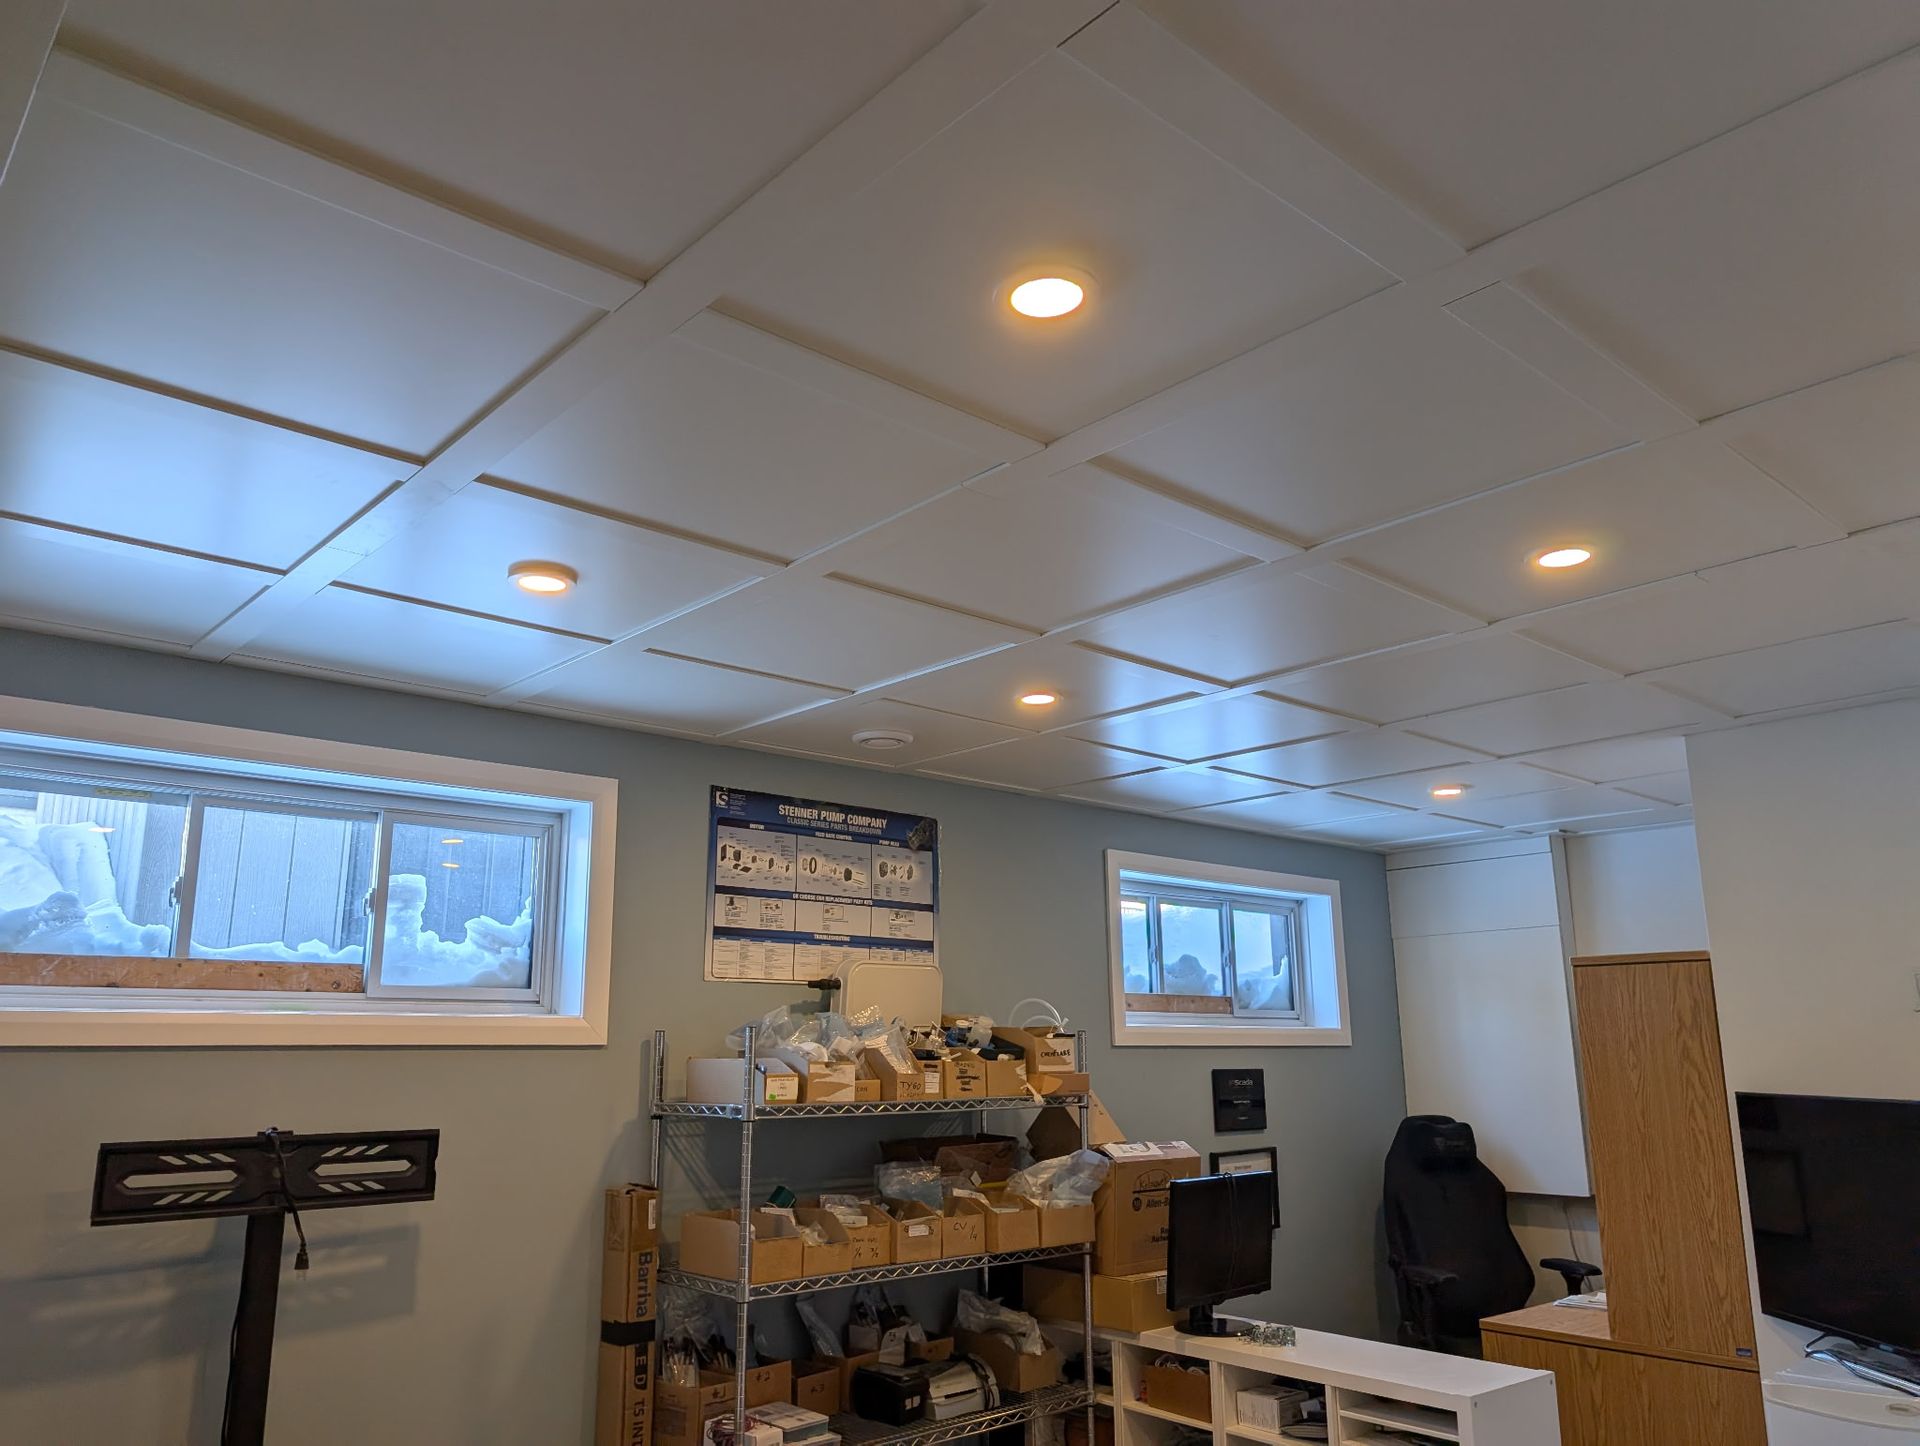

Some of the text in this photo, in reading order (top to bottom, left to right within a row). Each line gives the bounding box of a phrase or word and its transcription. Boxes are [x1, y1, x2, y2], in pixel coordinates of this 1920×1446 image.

[778, 804, 888, 829] STENNER PUMP COMPANY
[786, 817, 882, 836] CLASSIC SERIES PARTS BREAKDOWN
[636, 1251, 653, 1318] Barrina
